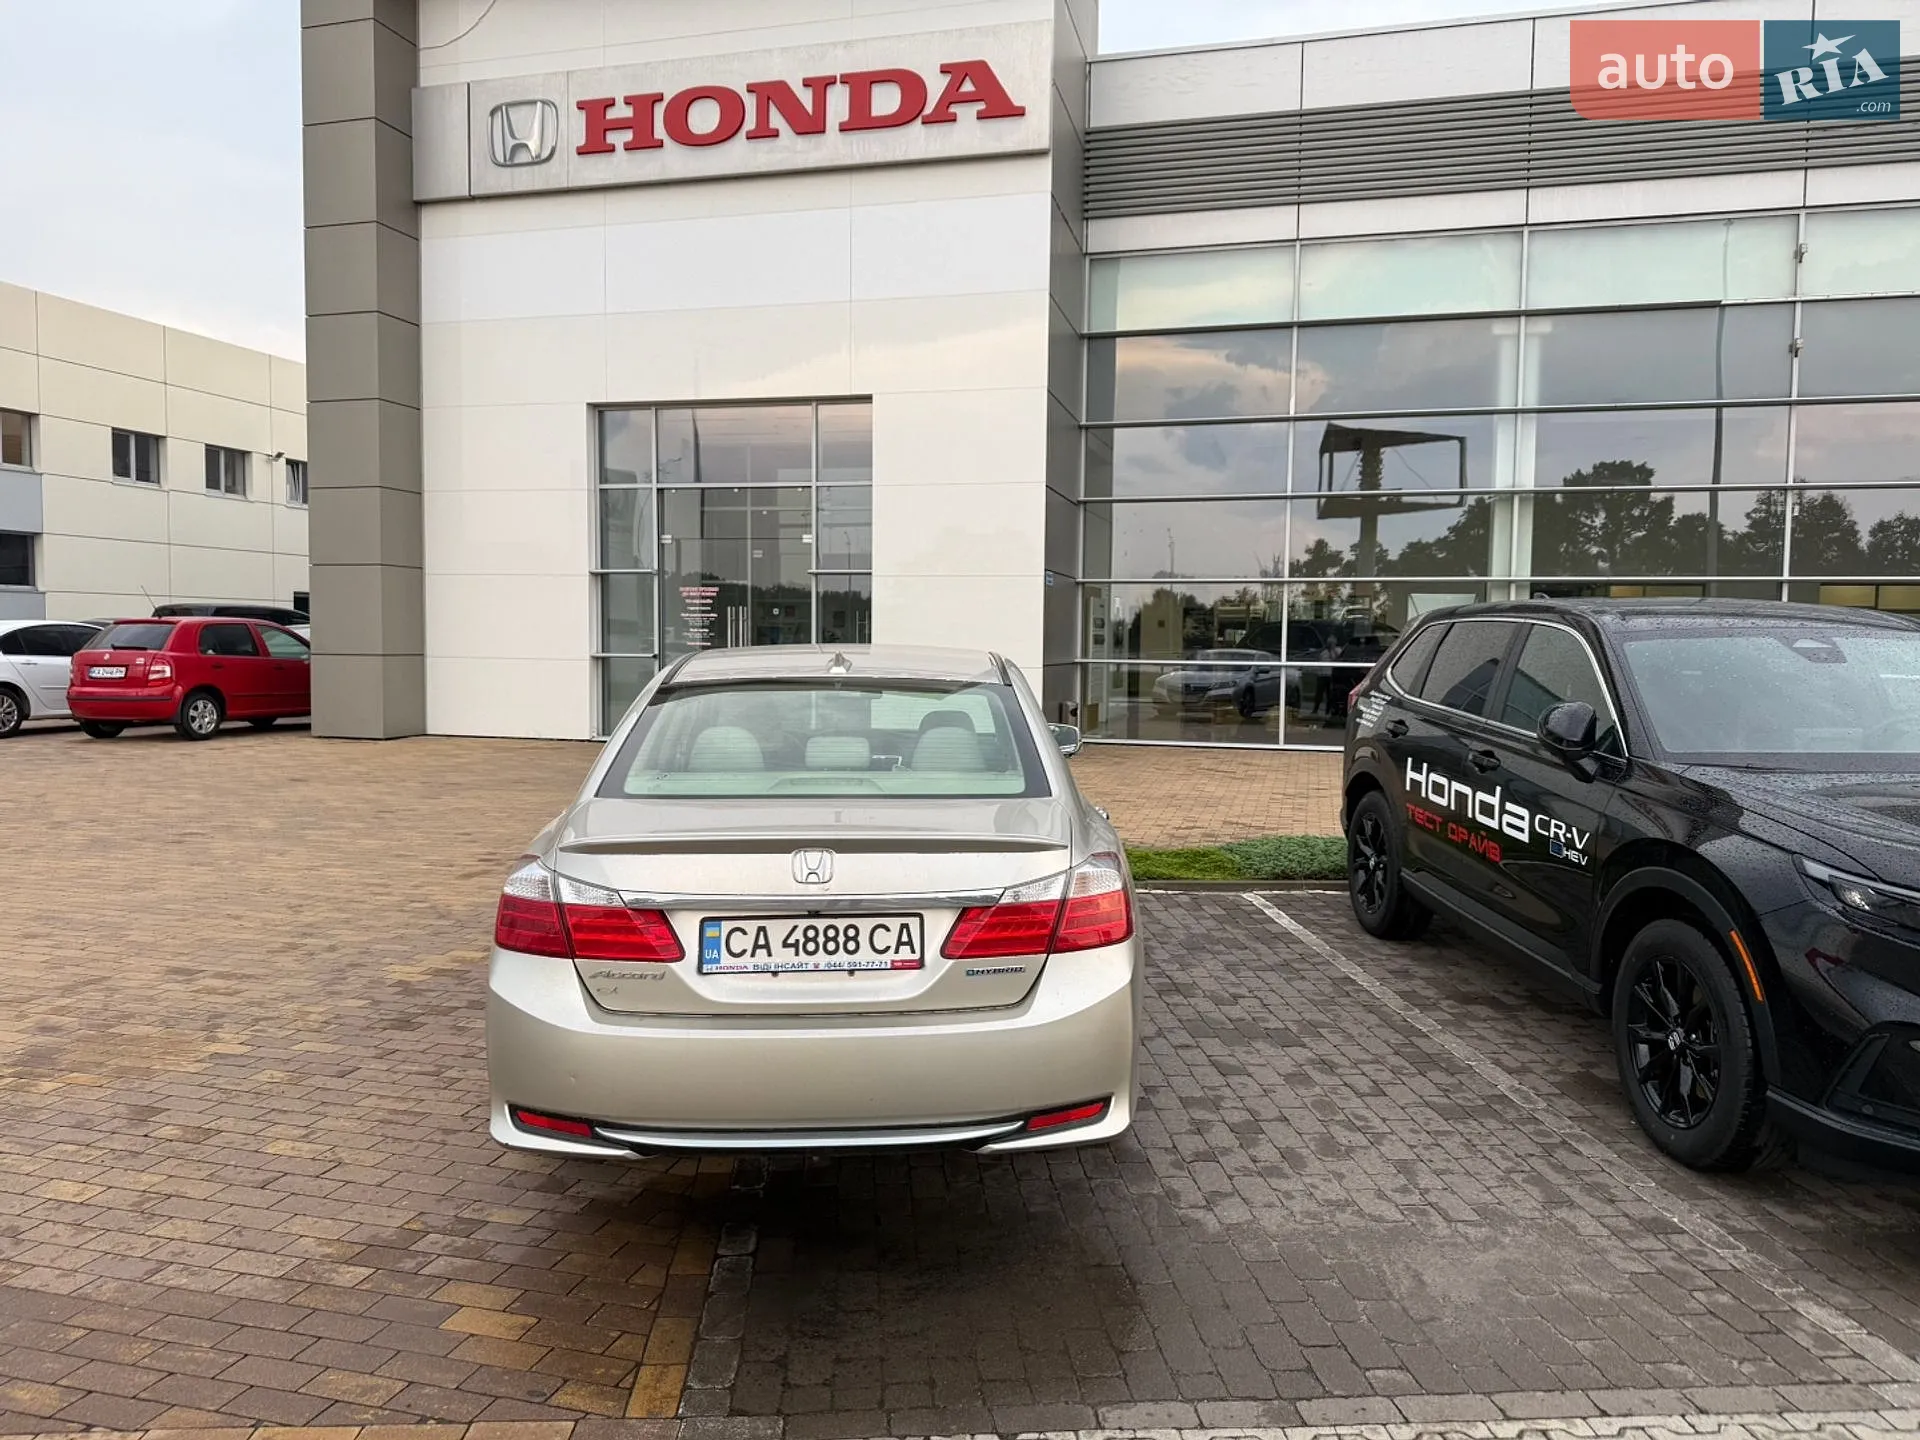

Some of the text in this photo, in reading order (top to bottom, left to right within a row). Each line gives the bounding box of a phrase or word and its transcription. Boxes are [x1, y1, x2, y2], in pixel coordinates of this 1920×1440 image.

[576, 59, 1026, 155] HONDA
[1405, 757, 1530, 844] Honda
[1534, 814, 1591, 850] CR-V
[705, 949, 719, 959] UA
[725, 922, 917, 958] CA 4888 CA
